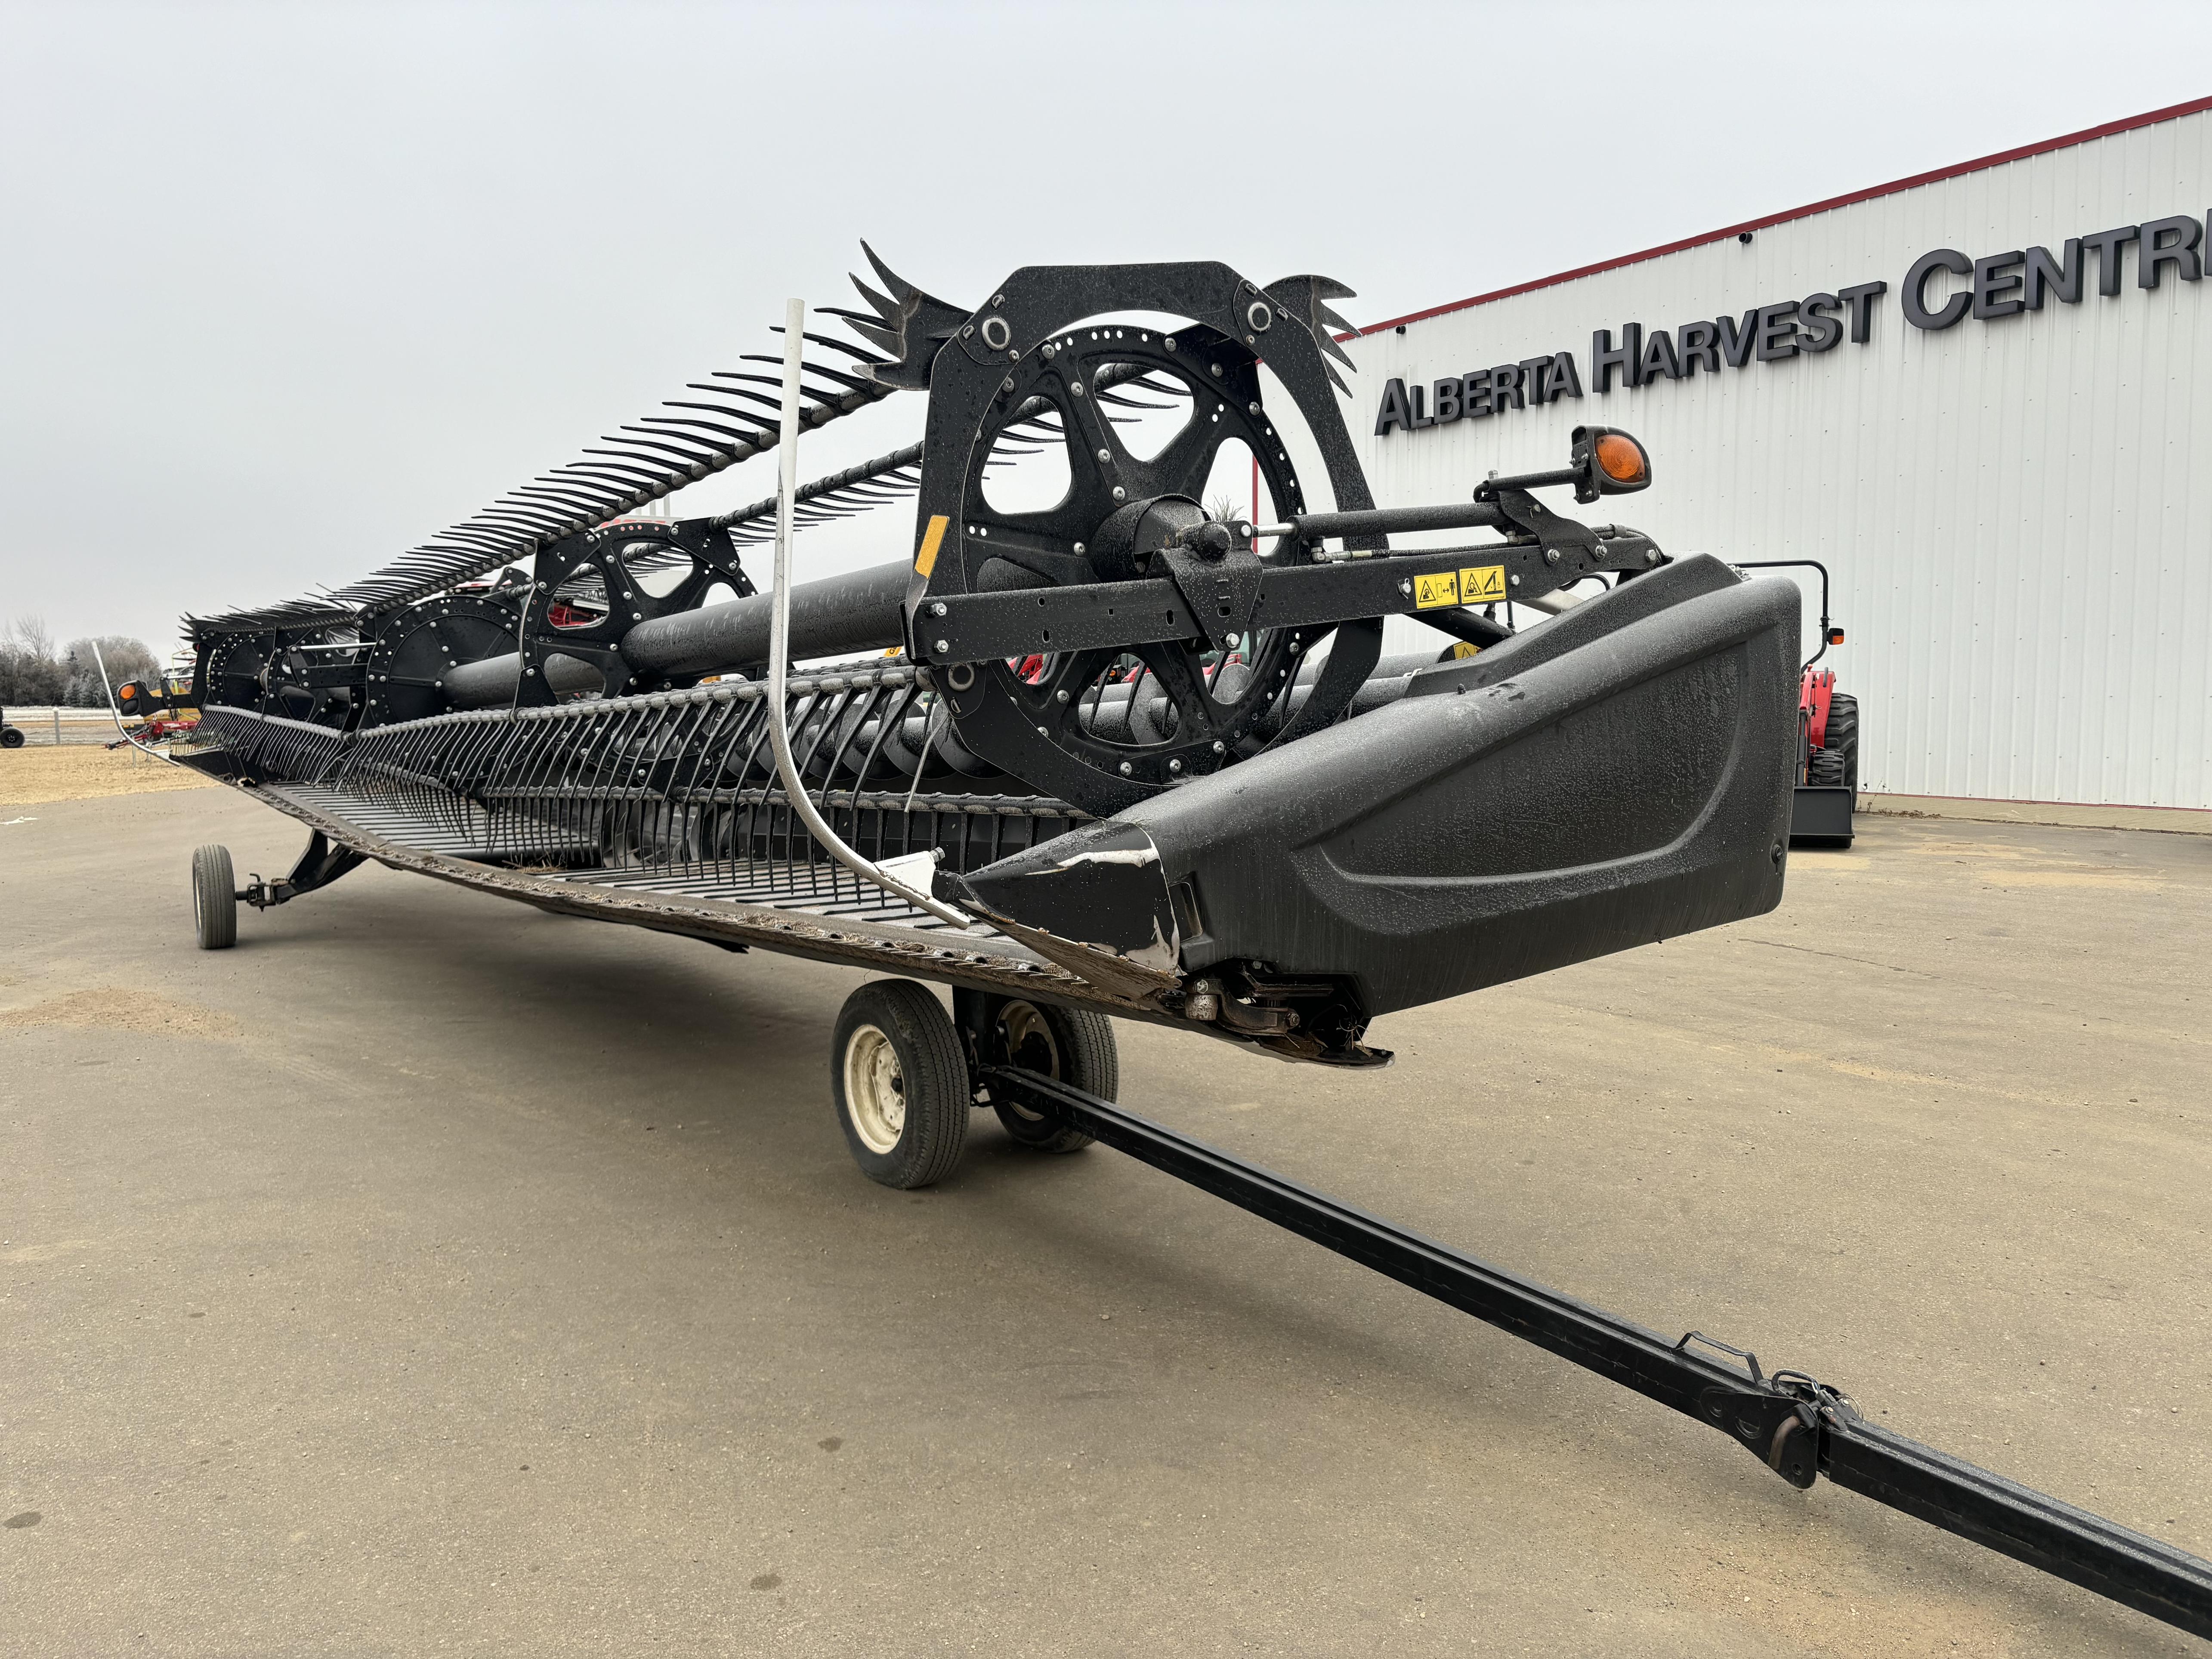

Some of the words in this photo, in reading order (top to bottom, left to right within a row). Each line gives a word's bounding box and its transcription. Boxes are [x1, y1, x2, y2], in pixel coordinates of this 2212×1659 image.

[1374, 352, 1583, 437] ALBERTA
[1593, 281, 1887, 394] HARVEST
[1901, 208, 2212, 331] CENTR
